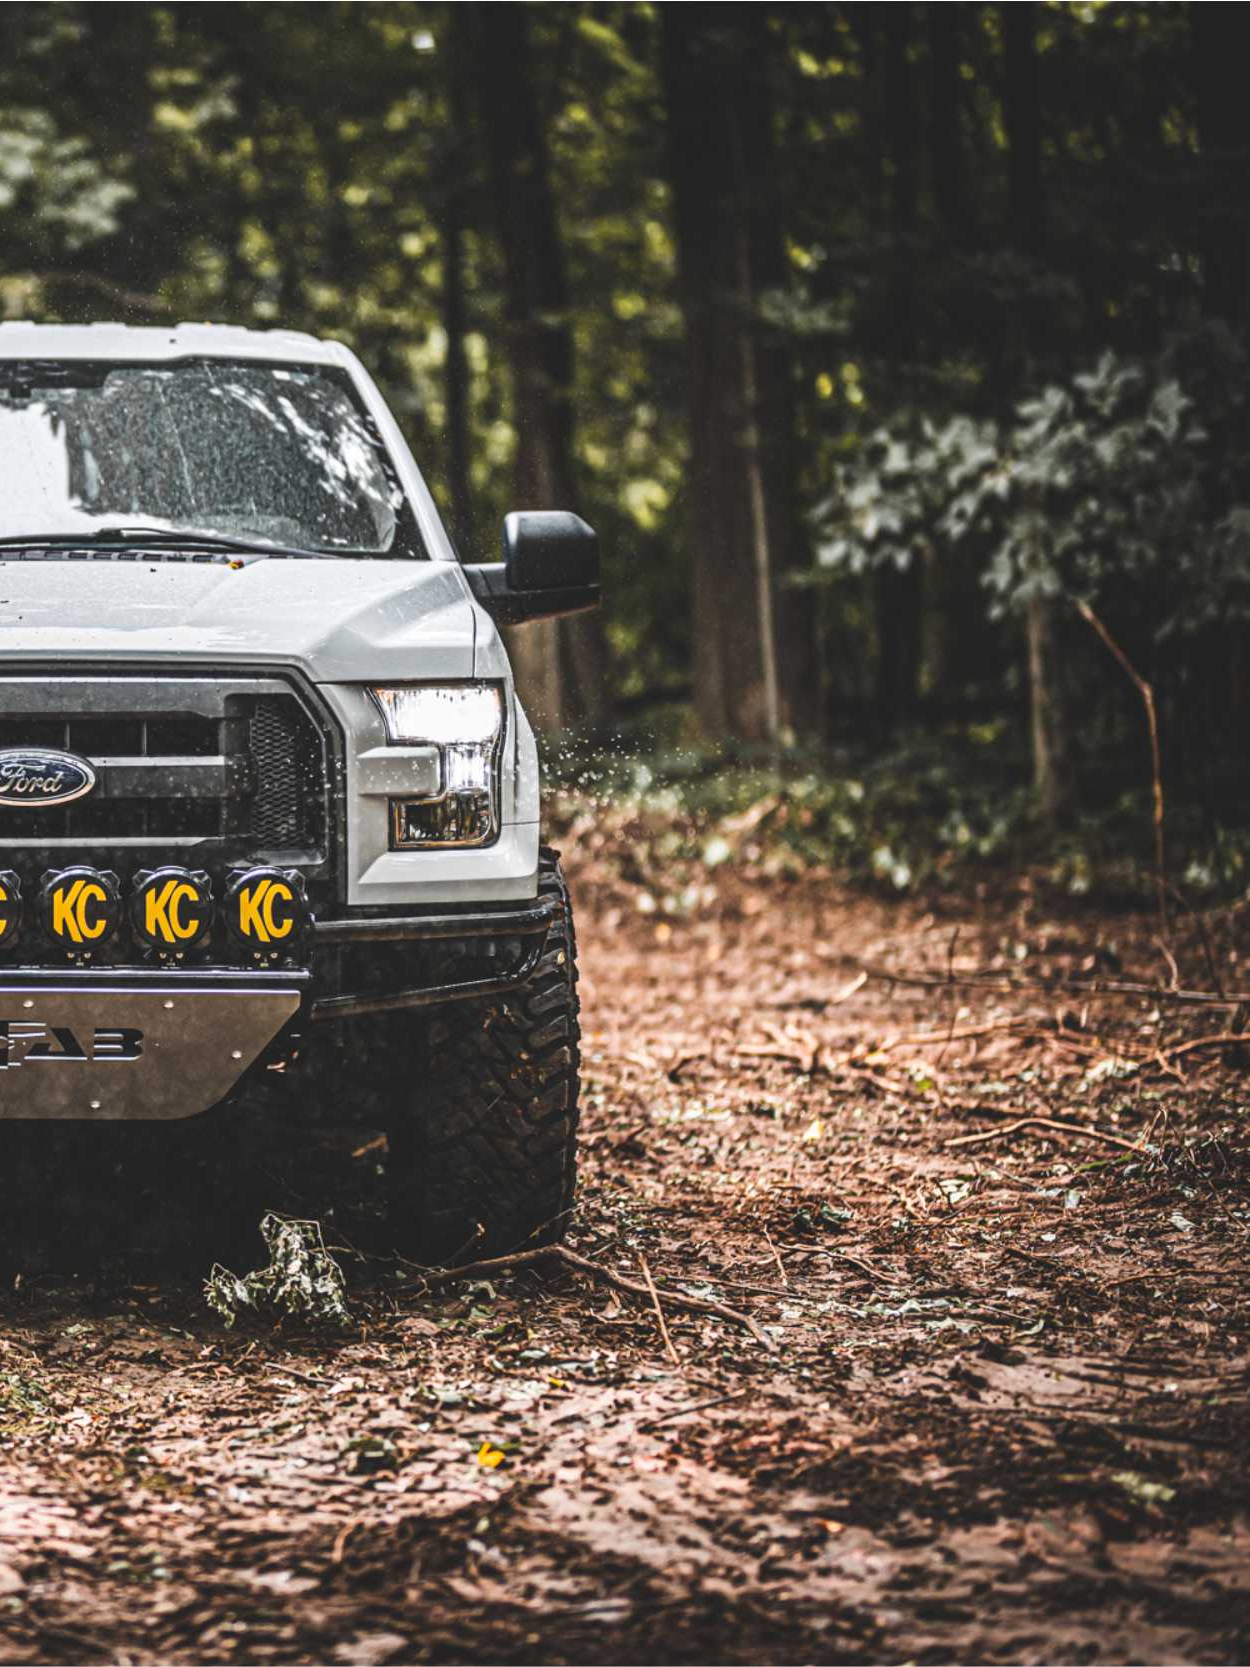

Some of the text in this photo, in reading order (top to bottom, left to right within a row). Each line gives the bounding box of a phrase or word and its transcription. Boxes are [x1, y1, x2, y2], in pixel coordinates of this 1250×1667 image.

[53, 880, 106, 942] KC
[146, 880, 199, 943] KC
[240, 880, 293, 943] KC
